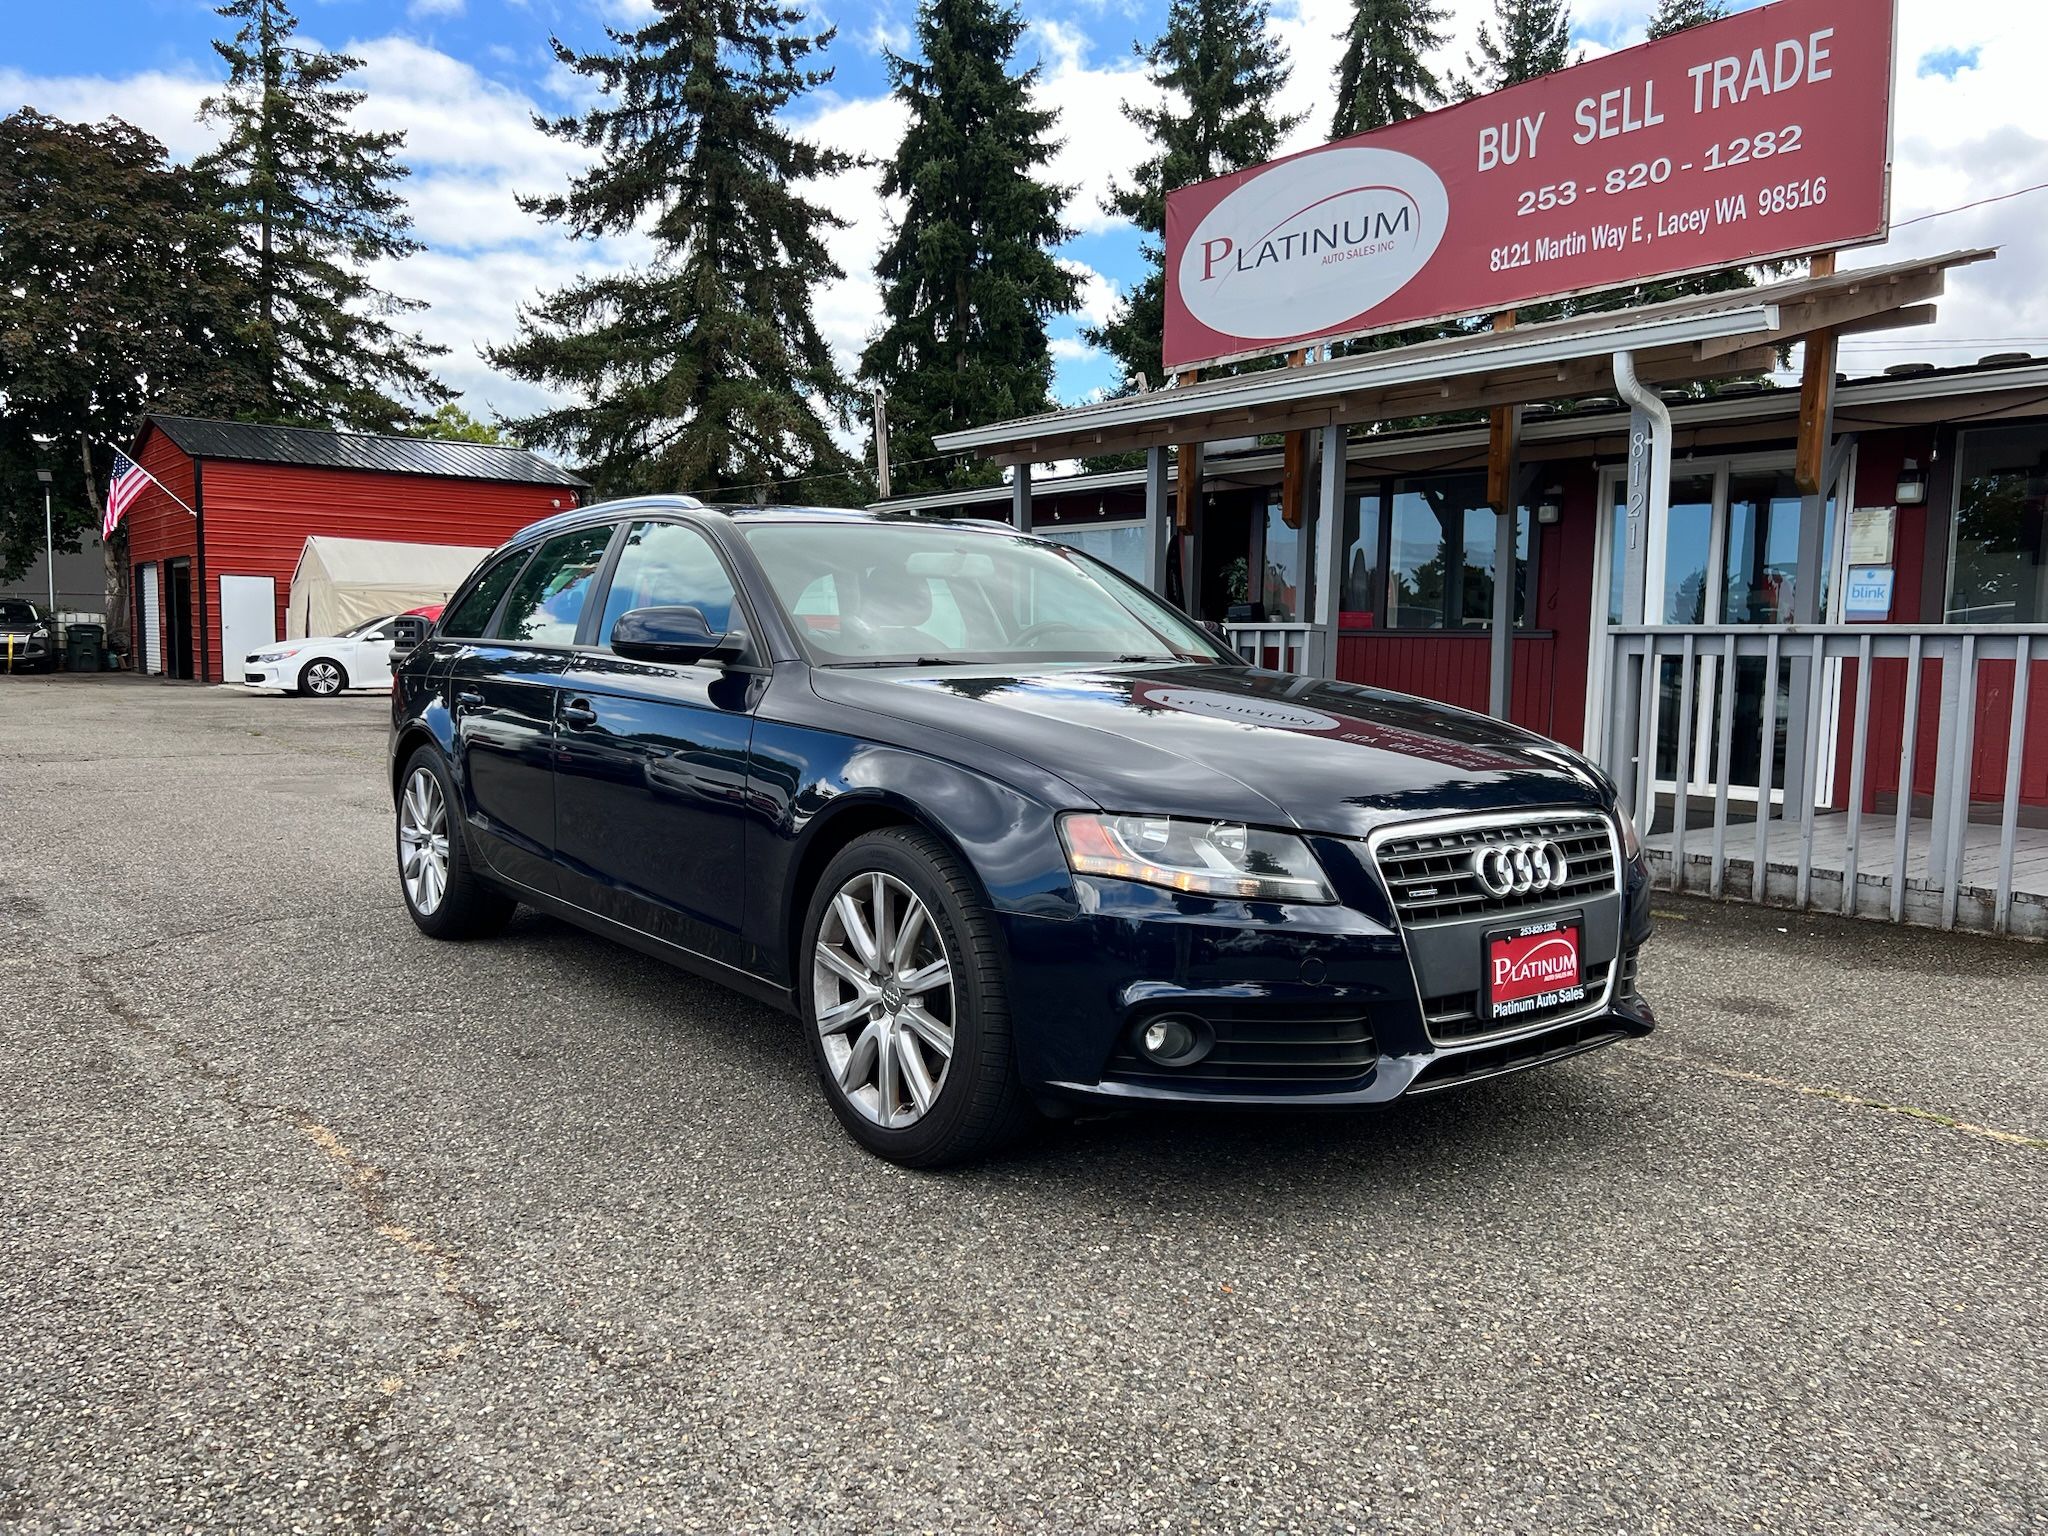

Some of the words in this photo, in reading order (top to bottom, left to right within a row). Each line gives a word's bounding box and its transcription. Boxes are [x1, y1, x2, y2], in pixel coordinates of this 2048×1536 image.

[1477, 111, 1546, 173] BUY
[1572, 79, 1665, 146] SELL
[1687, 27, 1835, 115] TRADE
[1516, 180, 1577, 217] 253
[1603, 157, 1673, 196] 820
[1702, 124, 1803, 173] 1282
[1199, 206, 1410, 282] PLATINUM
[1320, 251, 1345, 266] AUTO
[1346, 245, 1376, 260] SALES
[1377, 240, 1395, 253] INC
[1489, 242, 1531, 272] 8121
[1534, 231, 1587, 263] Martin
[1591, 223, 1628, 252] Way
[1657, 206, 1710, 237] Lacey
[1714, 194, 1747, 225] WA
[1758, 176, 1827, 217] 98516
[1627, 431, 1645, 550] 8121
[1851, 586, 1885, 599] blink
[1493, 954, 1577, 986] PLATINUM
[1493, 998, 1535, 1018] Platinum
[1536, 994, 1558, 1009] Auto
[1558, 987, 1585, 1004] Sales
